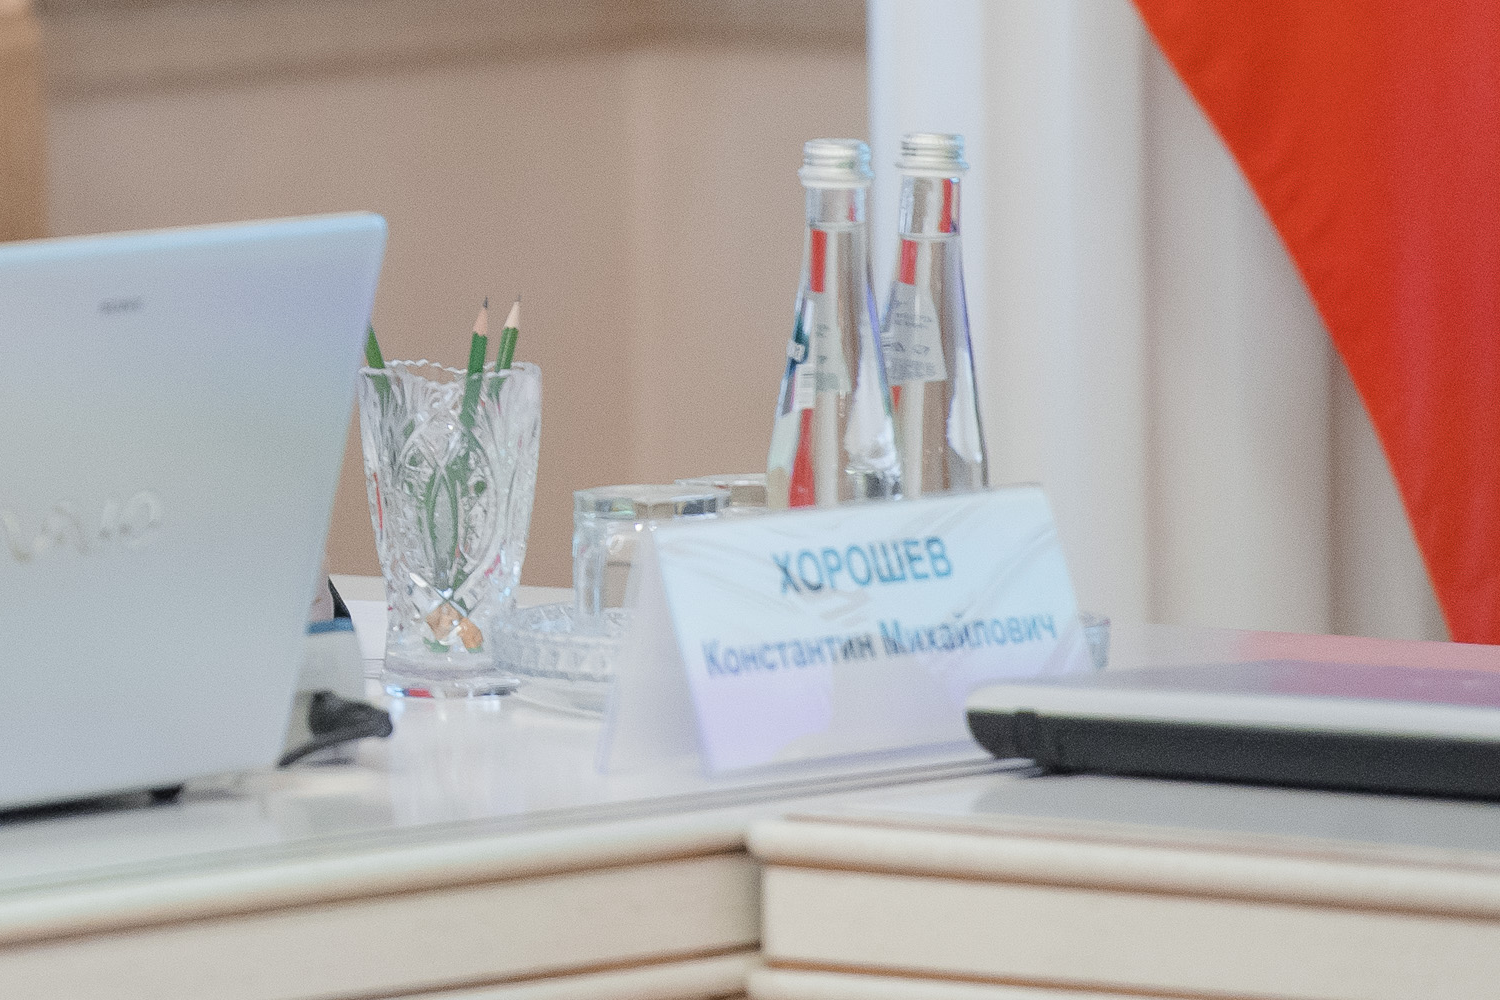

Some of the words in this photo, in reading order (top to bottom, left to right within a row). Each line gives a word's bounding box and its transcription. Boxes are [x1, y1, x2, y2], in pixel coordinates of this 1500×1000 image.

[773, 535, 954, 594] ХОРОШЕВ
[703, 632, 873, 677] Константин
[879, 610, 1057, 656] Михайлович
